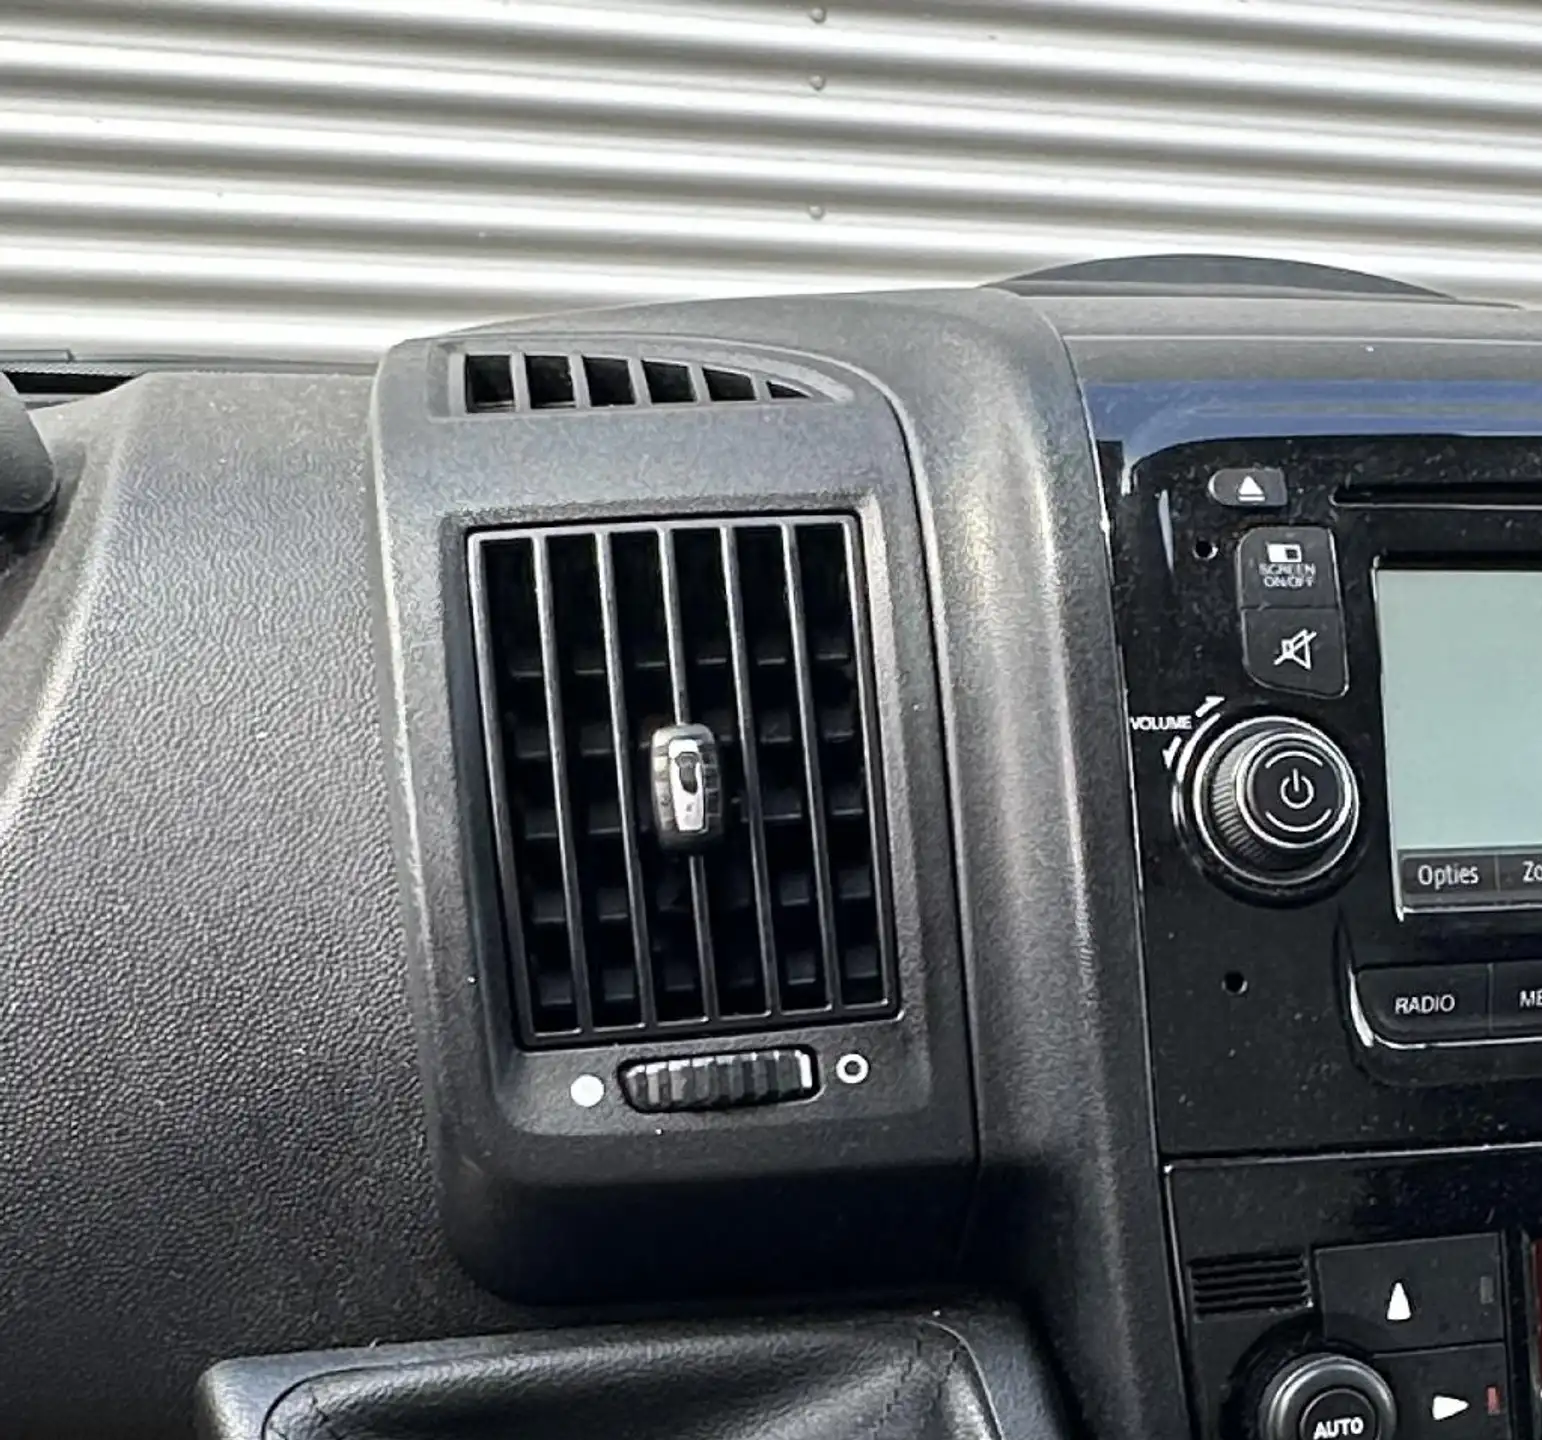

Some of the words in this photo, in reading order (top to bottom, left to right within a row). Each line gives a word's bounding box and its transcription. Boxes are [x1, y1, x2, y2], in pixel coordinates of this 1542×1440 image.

[1130, 716, 1192, 731] VOLUME
[1417, 863, 1479, 891] Opties
[1395, 993, 1456, 1014] RADIO
[1312, 1416, 1365, 1440] AUTO
